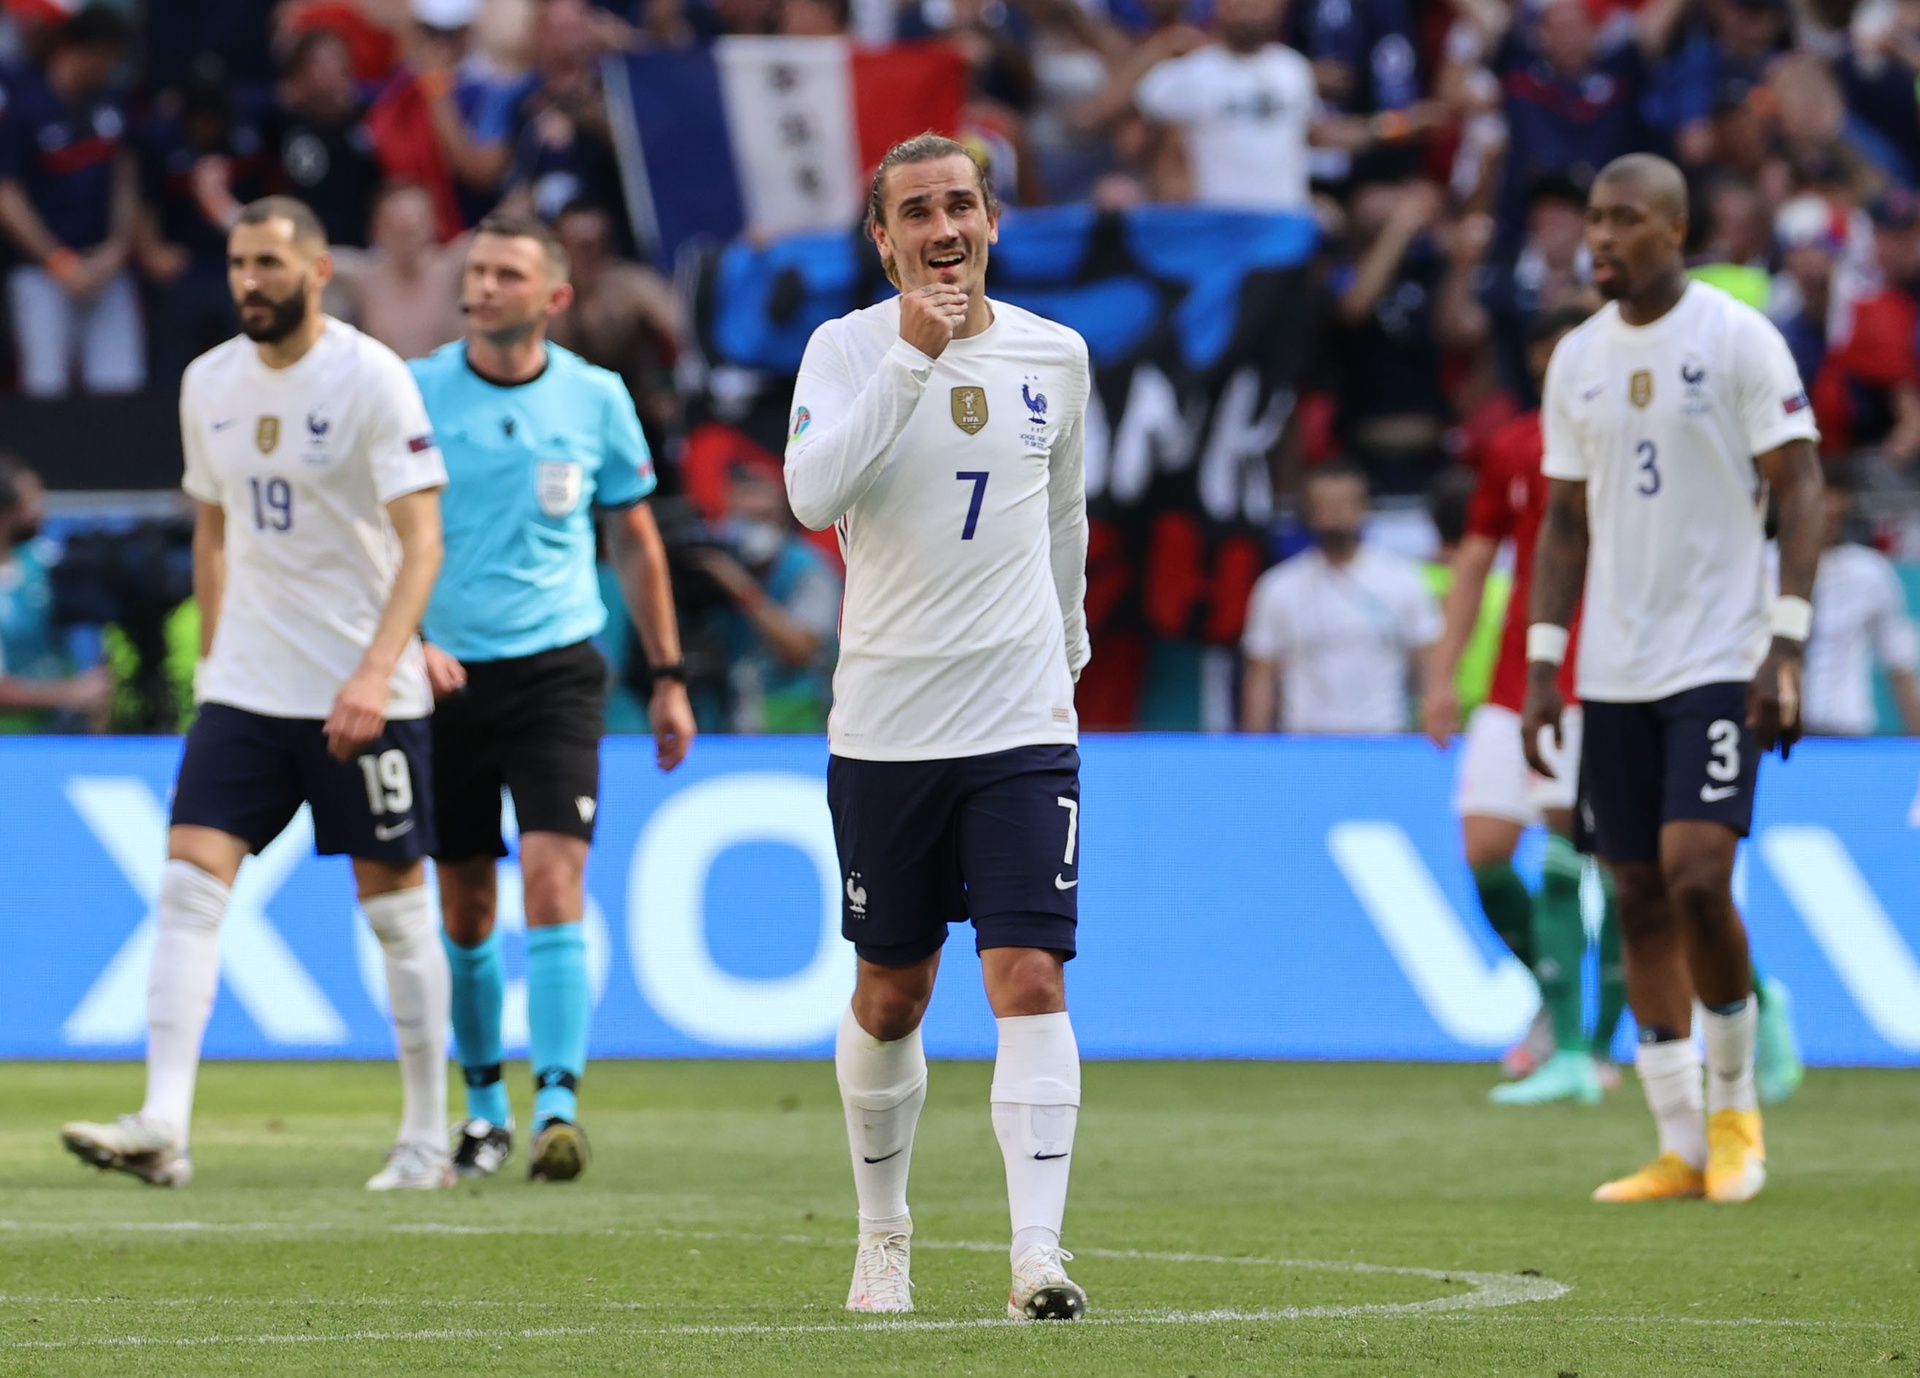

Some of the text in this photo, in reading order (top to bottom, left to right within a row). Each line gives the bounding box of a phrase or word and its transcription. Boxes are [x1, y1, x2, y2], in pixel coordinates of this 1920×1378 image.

[1636, 440, 1661, 496] 3
[249, 476, 293, 531] 19
[956, 471, 990, 540] 7
[357, 748, 414, 815] 19
[1705, 718, 1741, 782] 3
[1057, 796, 1079, 865] 7
